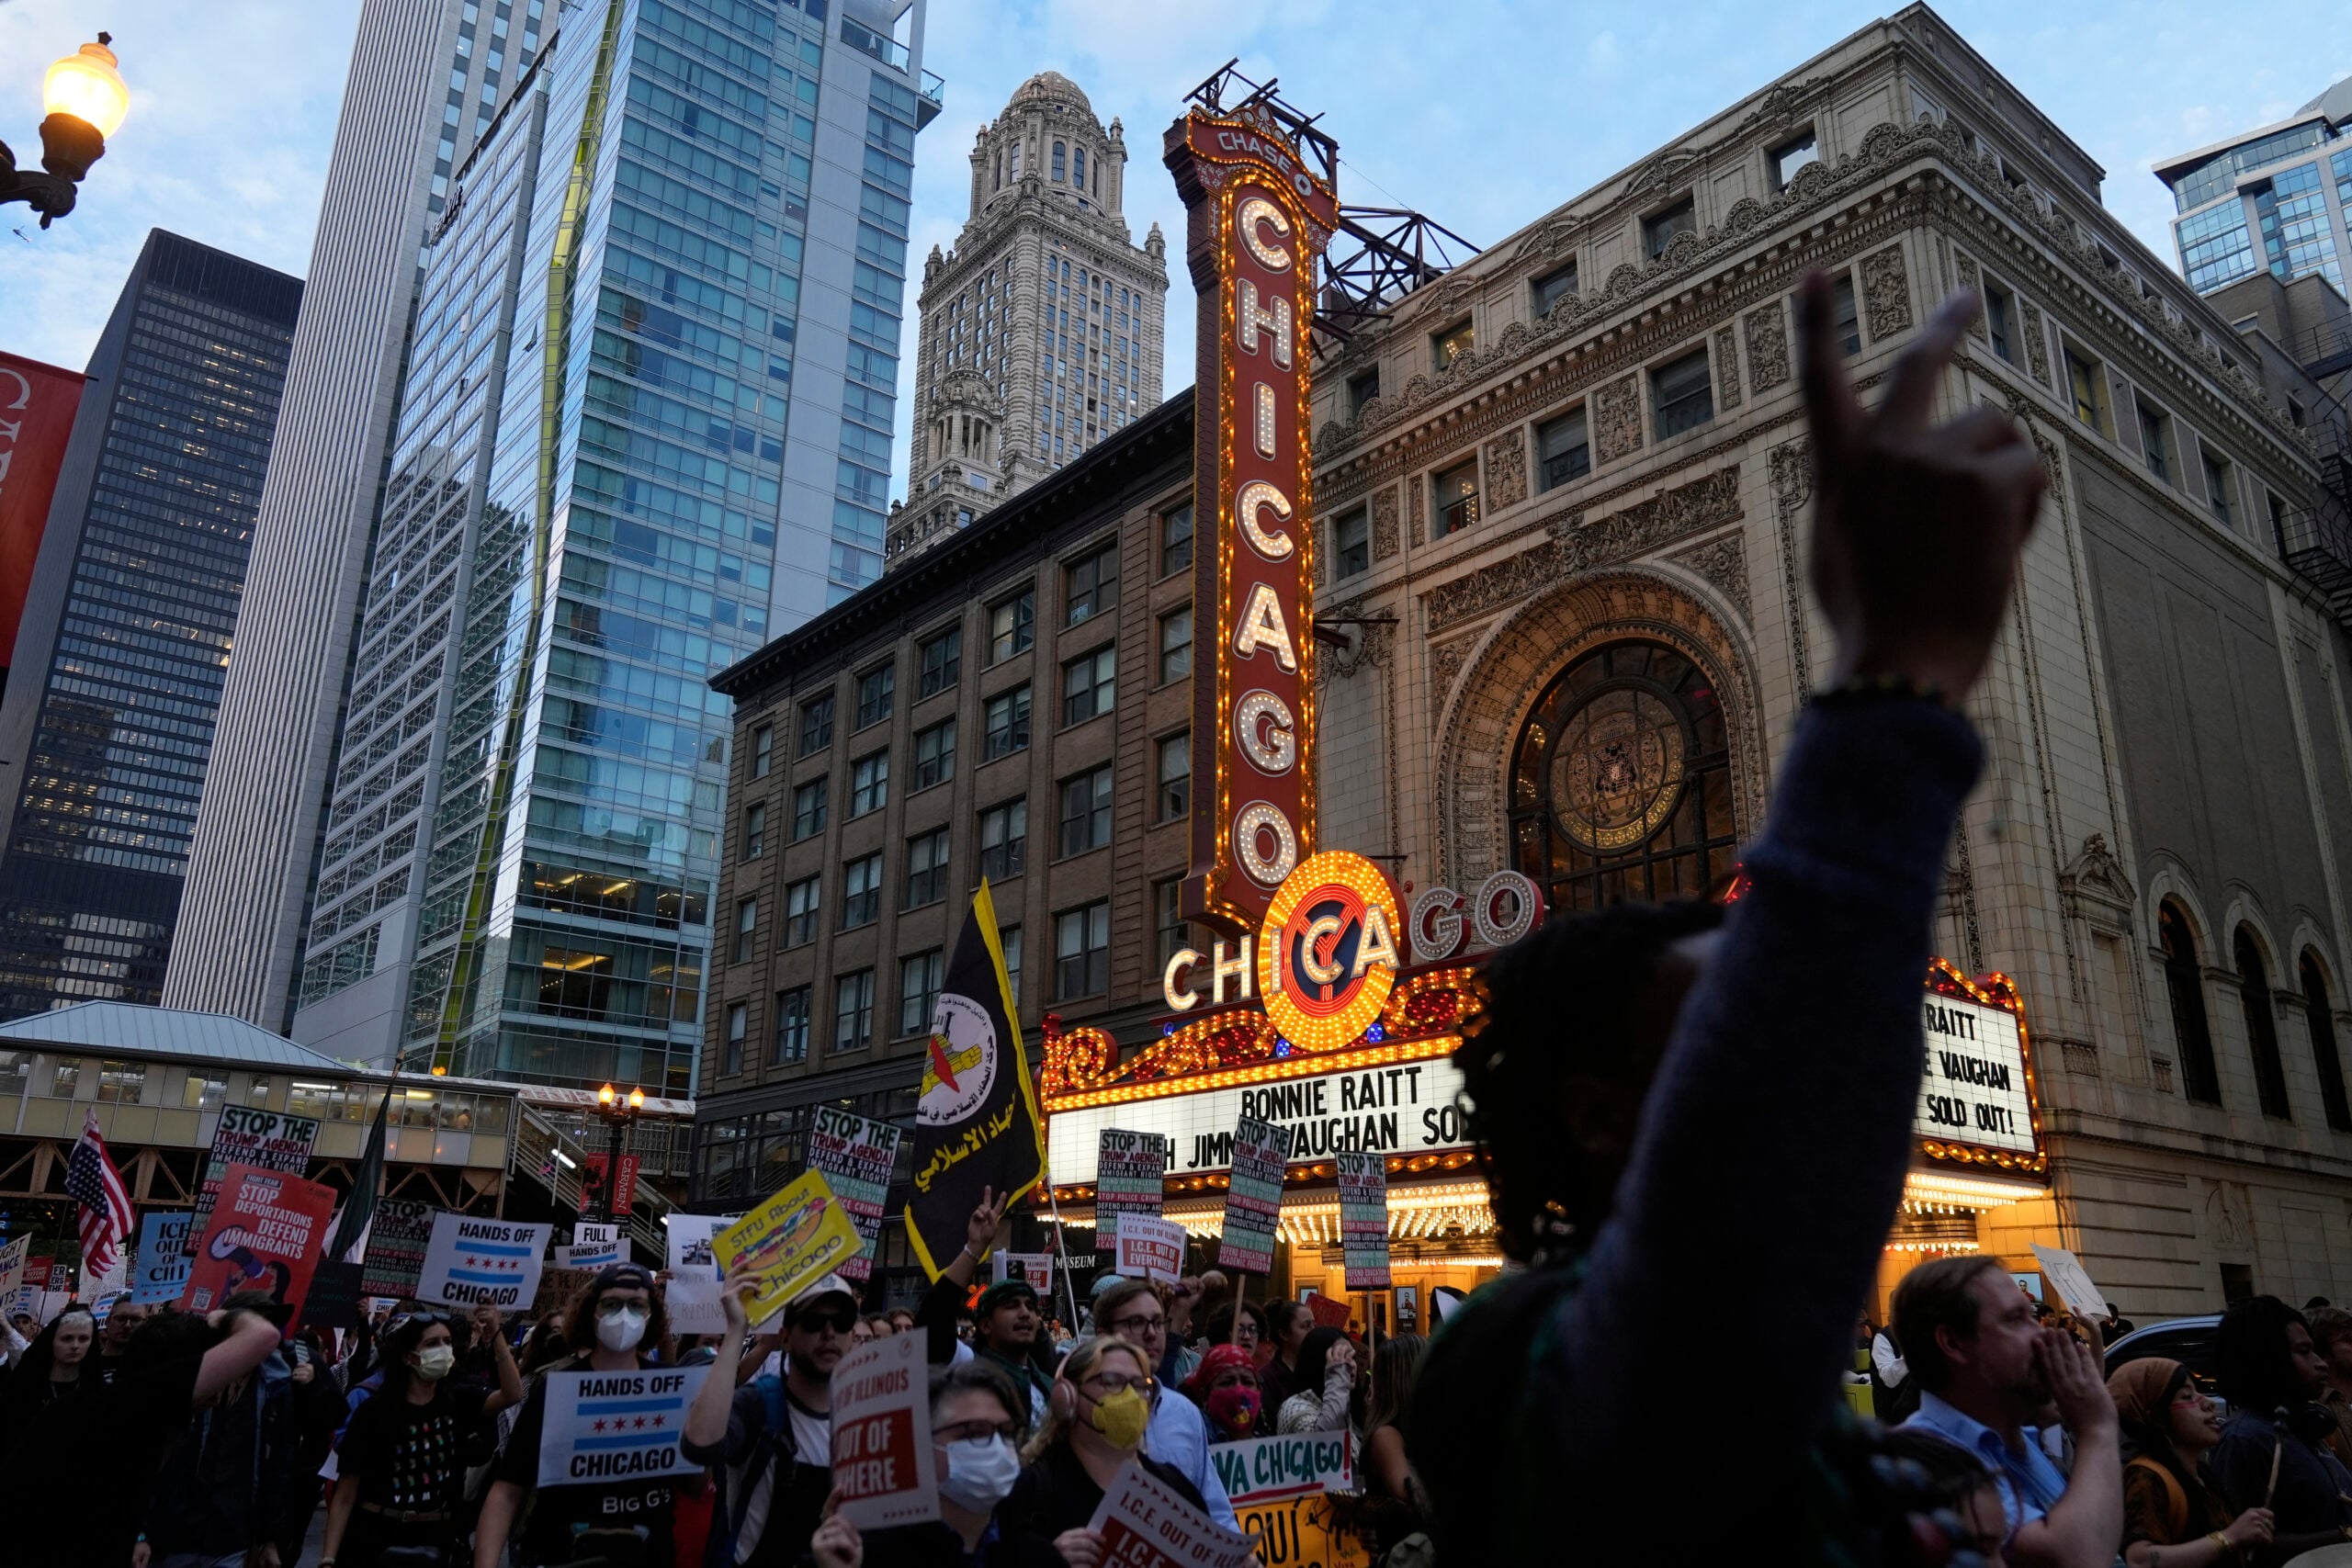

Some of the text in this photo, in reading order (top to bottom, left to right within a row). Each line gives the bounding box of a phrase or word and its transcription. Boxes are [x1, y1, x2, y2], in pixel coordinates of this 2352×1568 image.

[1217, 131, 1292, 175] CHASE
[1236, 197, 1296, 885] CHICAGO
[1163, 869, 1544, 1011] CHICAGO
[1925, 1002, 1975, 1041] RAITT
[1939, 1050, 2011, 1091] VAUGHAN
[1241, 1066, 1421, 1122] BONNIE RAITT
[1421, 1105, 1476, 1145] SOL
[1927, 1093, 2014, 1135] SOLD OUT!
[222, 1109, 315, 1142] STOP THE
[817, 1108, 899, 1150] STOP THE
[1238, 1120, 1289, 1153] STOP THE
[219, 1130, 311, 1156] TRUMP AGENDA!
[813, 1132, 895, 1166] TRUMP AGENDA!
[1101, 1133, 1163, 1153] STOP THE
[1235, 1141, 1286, 1167] TRUMP AGENDA!
[210, 1153, 270, 1168] IMMIGRANT
[212, 1144, 256, 1158] DEFEND
[272, 1153, 309, 1166] EXPAND
[809, 1146, 844, 1165] DEFEND
[857, 1160, 893, 1177] EXPAND
[1101, 1150, 1163, 1164] TRUMP AGENDA!
[1234, 1155, 1284, 1177] DEFEND EXPAND
[1338, 1154, 1384, 1176] STOP THE
[807, 1157, 890, 1186] IMMIGRANT RIGHTS
[1098, 1169, 1136, 1178] IMMIGRANT
[1099, 1161, 1125, 1171] DEFEND
[1137, 1163, 1164, 1172] EXPAND
[202, 1181, 221, 1192] STO
[617, 1157, 632, 1210] CARMEN
[1339, 1174, 1361, 1187] TRUMP
[239, 1183, 280, 1204] STOP
[1097, 1192, 1115, 1201] STOP
[1117, 1193, 1138, 1201] POLICE
[234, 1200, 313, 1229] DEPORTATIONS
[379, 1200, 427, 1219] STOP
[854, 1201, 885, 1215] CRIMES
[1097, 1201, 1121, 1211] DEFEND
[373, 1223, 410, 1234] DEFEND
[375, 1213, 413, 1227] TRUMP
[865, 1217, 882, 1228] AND
[257, 1219, 310, 1245] DEFEND
[458, 1222, 536, 1243] HANDS OFF
[583, 1227, 608, 1242] FULL
[730, 1218, 765, 1249] STFU
[1096, 1234, 1117, 1242] DEFEN
[223, 1228, 304, 1259] IMMIGRANTS
[569, 1242, 618, 1258] HANDS OFF
[1095, 1241, 1117, 1249] ACAD
[1130, 1240, 1176, 1258] I.C.E. OUT OF
[365, 1261, 422, 1274] REPRODUCTIV
[754, 1234, 842, 1302] Chicago
[836, 1267, 872, 1280] REEDOM
[1130, 1253, 1175, 1273] EVERYWHERE
[442, 1281, 518, 1305] CHICAGO
[579, 1375, 684, 1397] HANDS OFF
[855, 1367, 910, 1403] ILLINOIS
[866, 1416, 893, 1455] OF
[570, 1447, 676, 1478] CHICAGO
[1254, 1430, 1351, 1485] CHICAGO!
[603, 1495, 640, 1514] BIG
[1119, 1491, 1157, 1529] I.C.E.
[1159, 1520, 1193, 1550] OUT
[1194, 1542, 1212, 1563] OF
